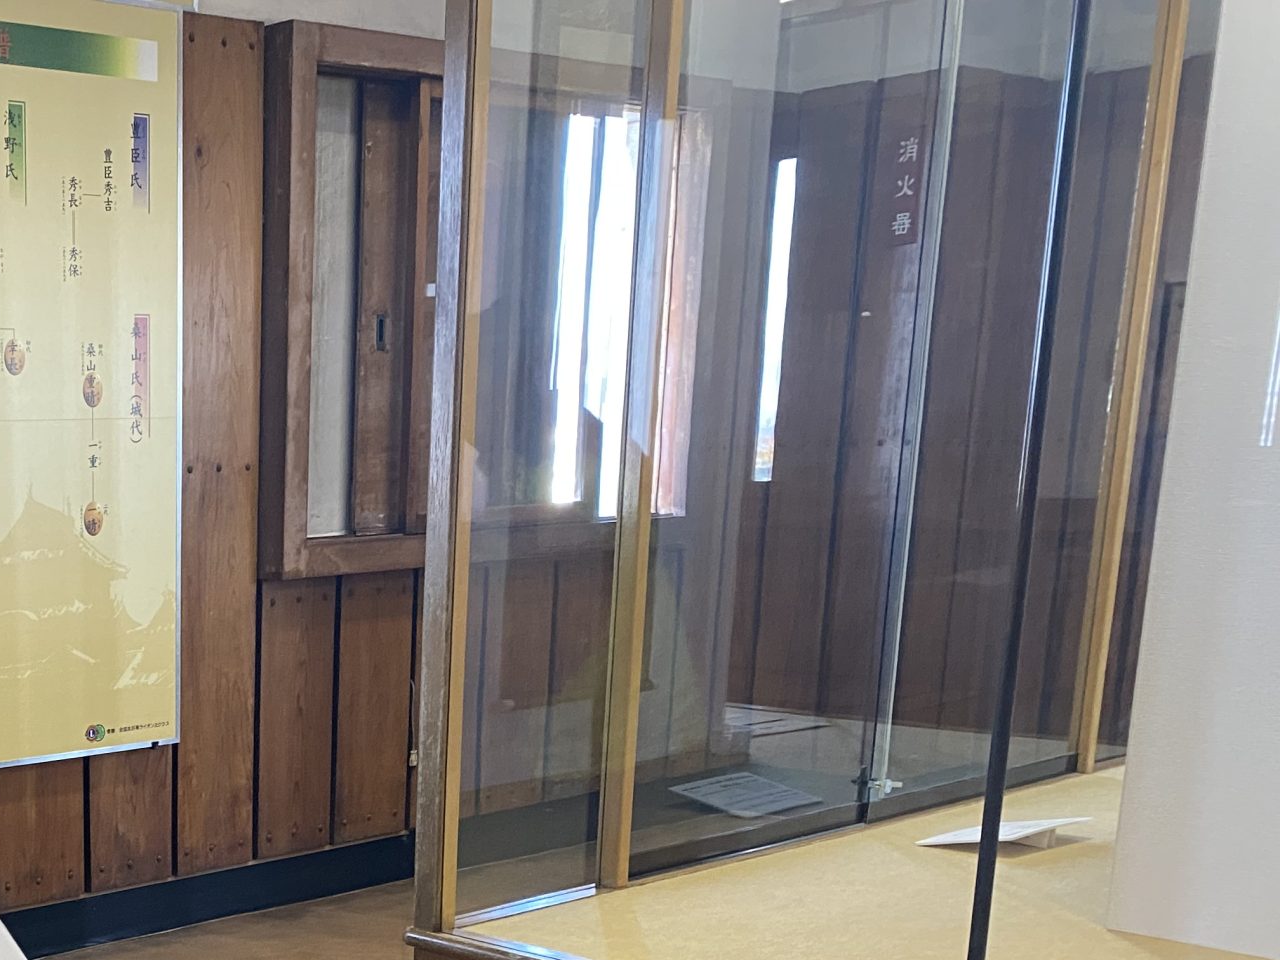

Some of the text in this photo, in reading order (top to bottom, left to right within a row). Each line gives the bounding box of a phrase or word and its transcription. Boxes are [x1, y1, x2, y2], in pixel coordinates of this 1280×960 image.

[3, 109, 18, 181] 浅野氏
[68, 176, 79, 208] 秀長
[891, 137, 920, 235] 消火器
[68, 246, 80, 278] 秀保
[129, 322, 143, 444] 桑山氏（城代）
[87, 443, 98, 469] 一重
